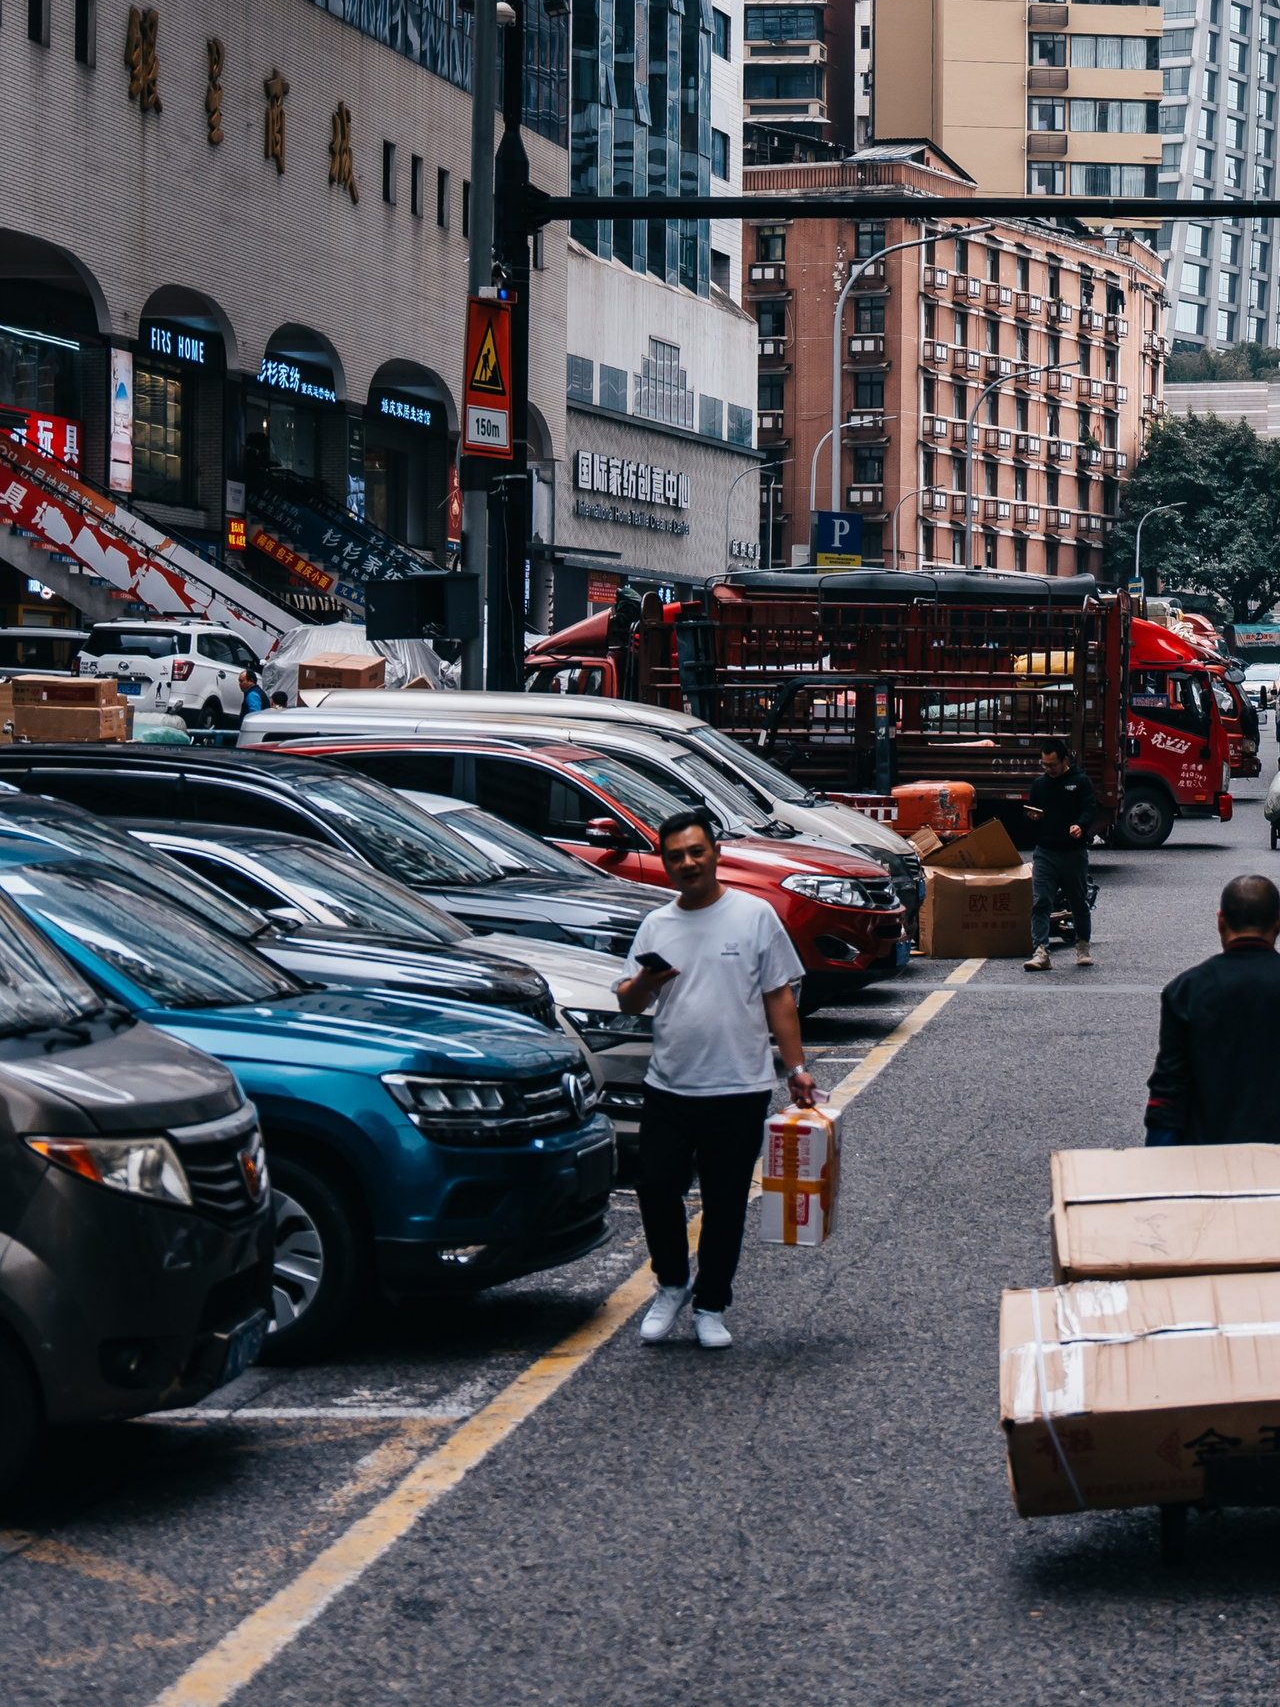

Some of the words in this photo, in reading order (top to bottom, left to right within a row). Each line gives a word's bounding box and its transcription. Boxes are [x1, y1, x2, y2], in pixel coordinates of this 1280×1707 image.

[151, 326, 172, 354] FIRS
[178, 335, 205, 364] HOME
[475, 417, 500, 438] 150m
[577, 450, 691, 509] 国际家纺创意中心
[673, 519, 691, 535] Center
[831, 518, 850, 548] P
[277, 547, 293, 564] 包子
[294, 559, 331, 589] 重庆小面
[1126, 721, 1147, 736] 重庆
[969, 894, 1012, 913] 欧暖
